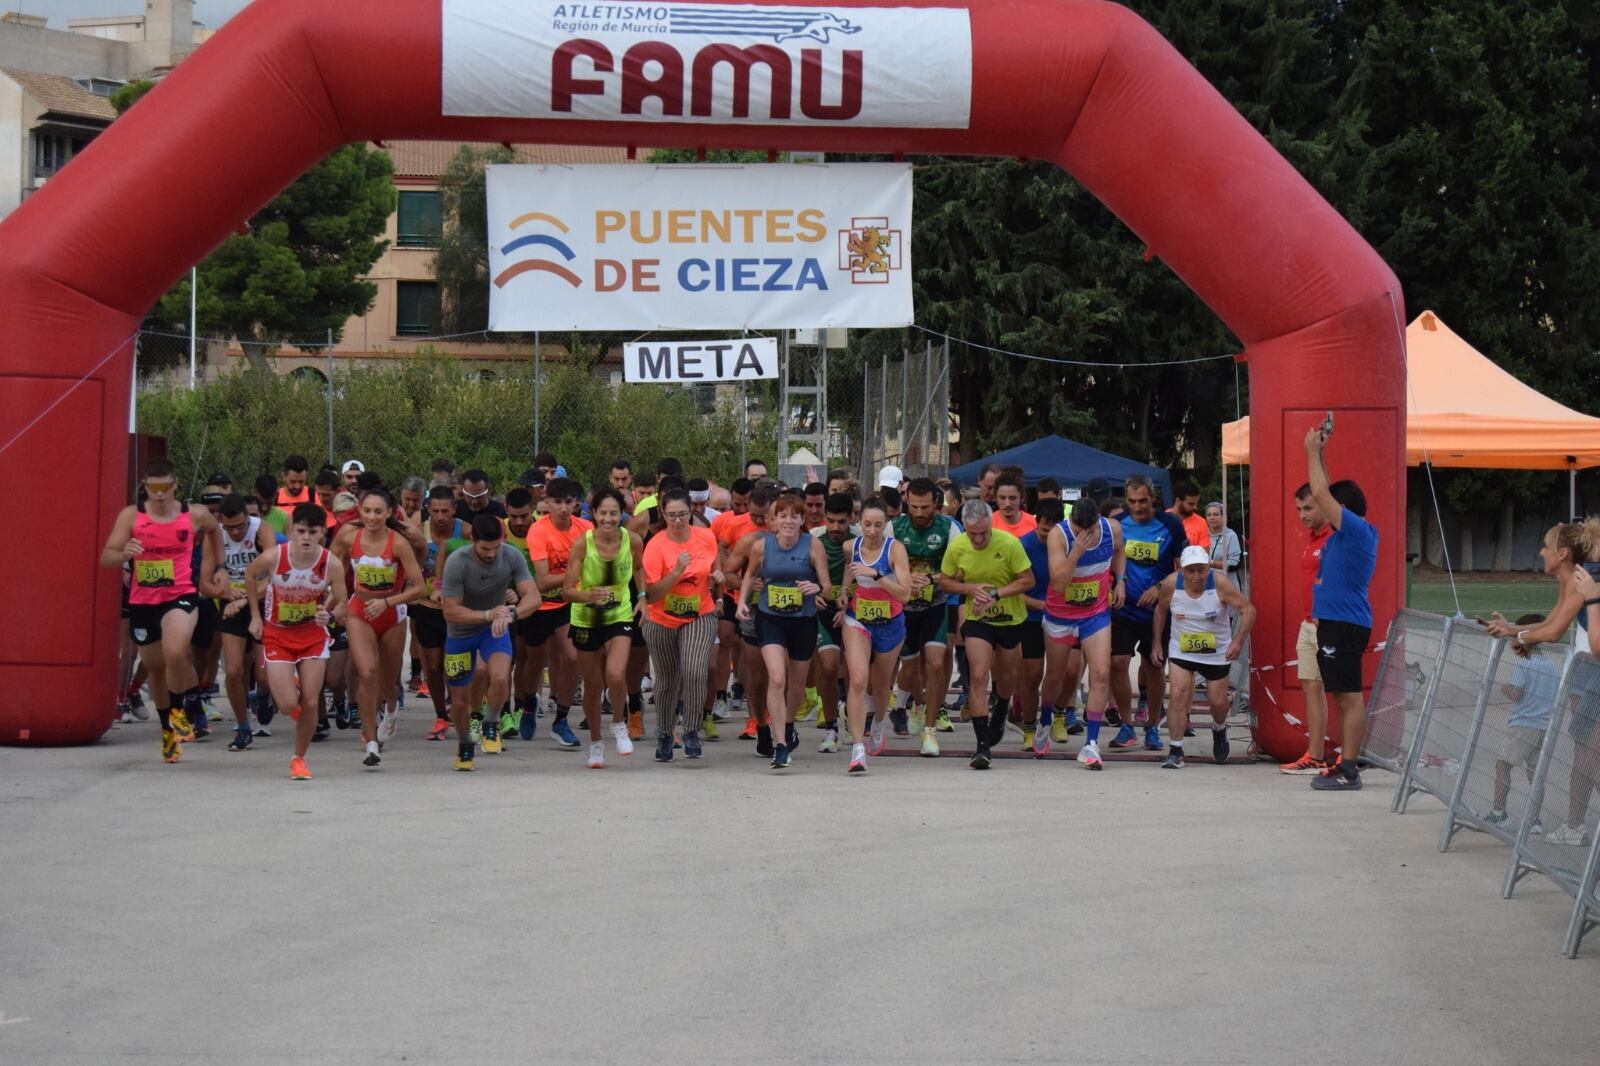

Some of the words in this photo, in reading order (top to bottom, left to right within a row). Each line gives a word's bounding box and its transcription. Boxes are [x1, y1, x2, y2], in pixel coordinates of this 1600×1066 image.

[553, 4, 669, 20] ATLETISMO
[552, 20, 598, 33] Región
[602, 22, 618, 32] de
[621, 22, 667, 33] Murcia
[551, 38, 863, 121] FAMU
[595, 208, 827, 245] PUENTES
[595, 258, 660, 292] DE
[677, 257, 829, 293] CIEZA
[638, 344, 764, 380] META
[1131, 546, 1151, 558] 359
[144, 567, 166, 579] 301
[365, 572, 386, 583] 313
[774, 593, 795, 605] 345
[1073, 588, 1093, 600] 378
[672, 601, 694, 612] 306
[862, 606, 883, 617] 340
[1187, 639, 1209, 650] 366
